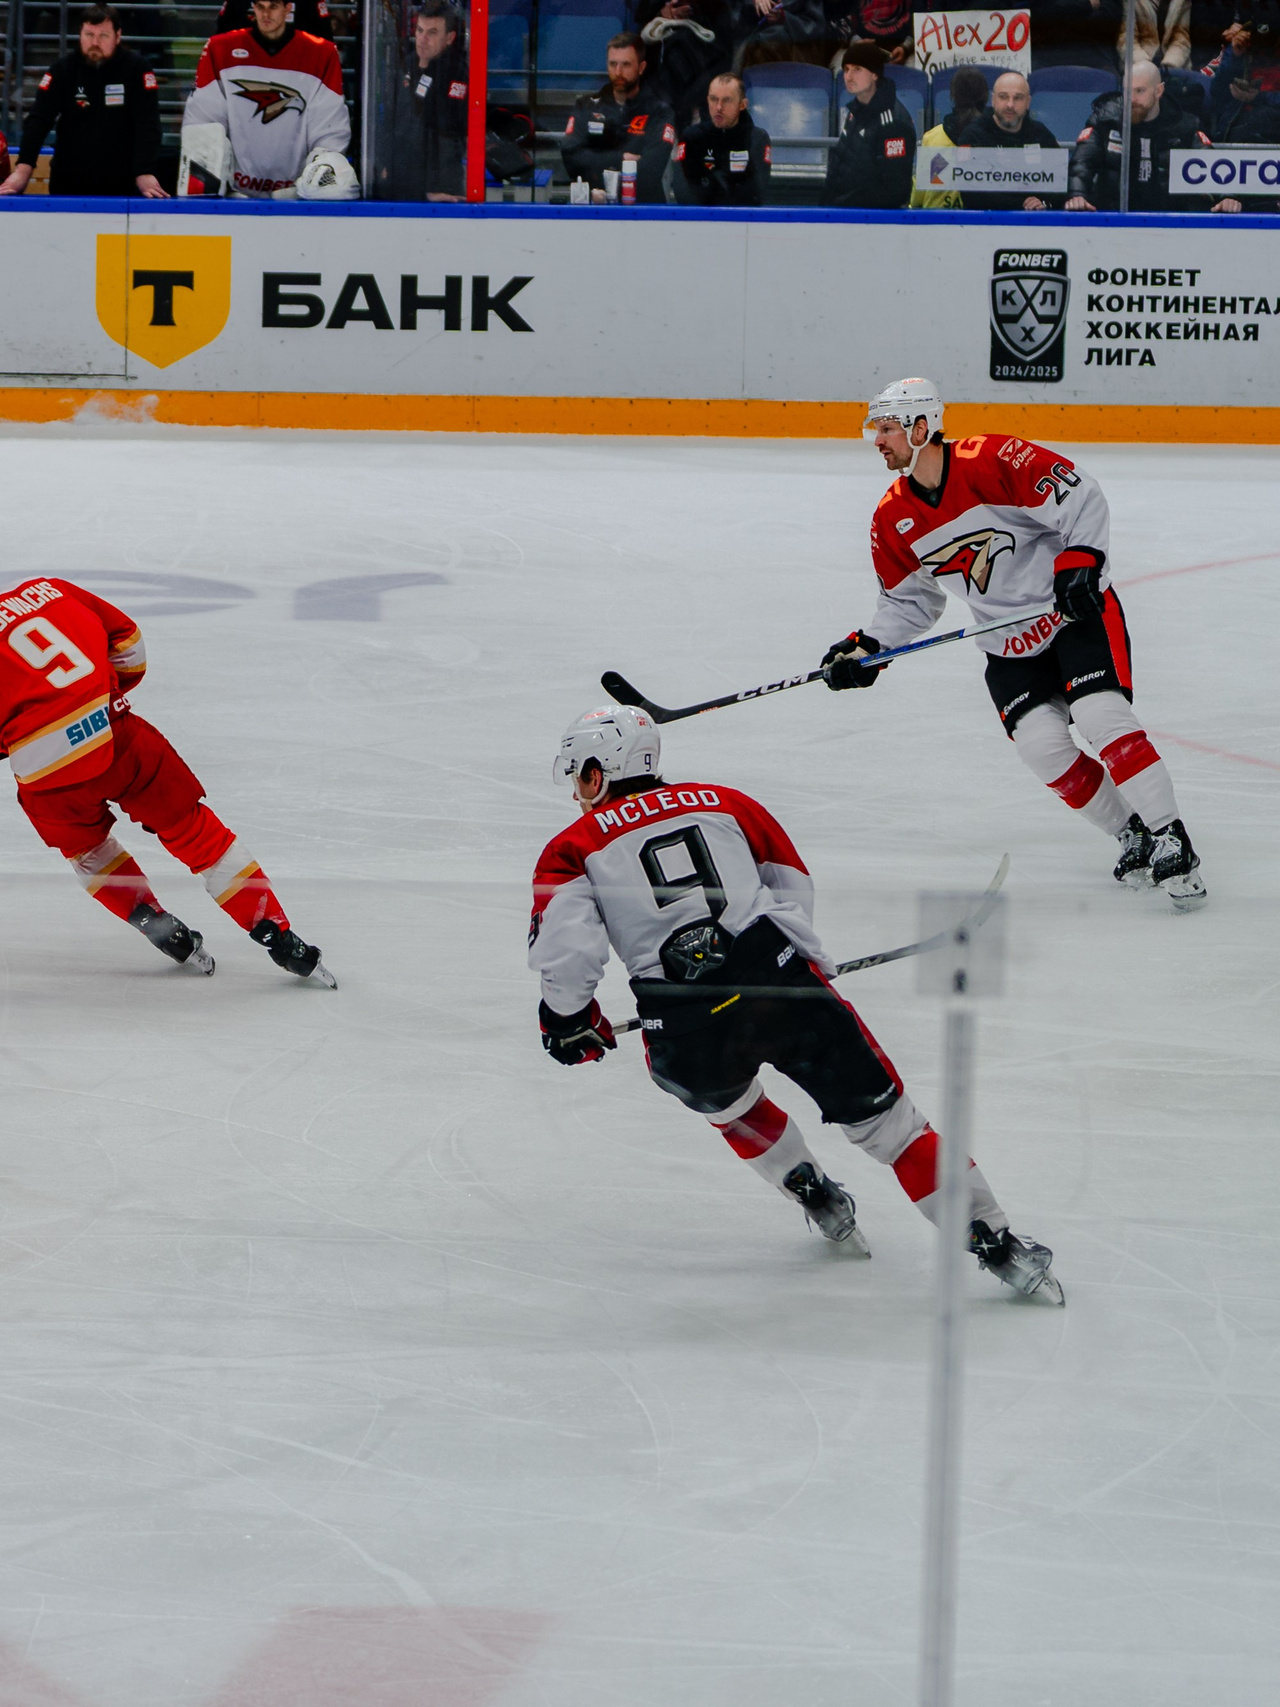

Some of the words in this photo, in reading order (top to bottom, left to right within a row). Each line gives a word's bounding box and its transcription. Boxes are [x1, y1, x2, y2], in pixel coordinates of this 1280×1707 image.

[952, 167, 1054, 185] Ростелеком
[997, 253, 1062, 268] FONBET
[1087, 267, 1201, 287] ФОНБЕТ
[262, 271, 534, 333] БАНК
[1085, 318, 1260, 342] ХОККЕЙНАЯ
[1084, 348, 1156, 367] ЛИГА
[994, 365, 1058, 378] 2024/2025
[1035, 462, 1082, 507] 20
[7, 616, 96, 689] 9
[736, 673, 809, 702] CCM
[66, 706, 110, 747] SIB
[644, 753, 652, 772] 9
[593, 788, 722, 834] MCLEOD
[637, 824, 729, 922] 9
